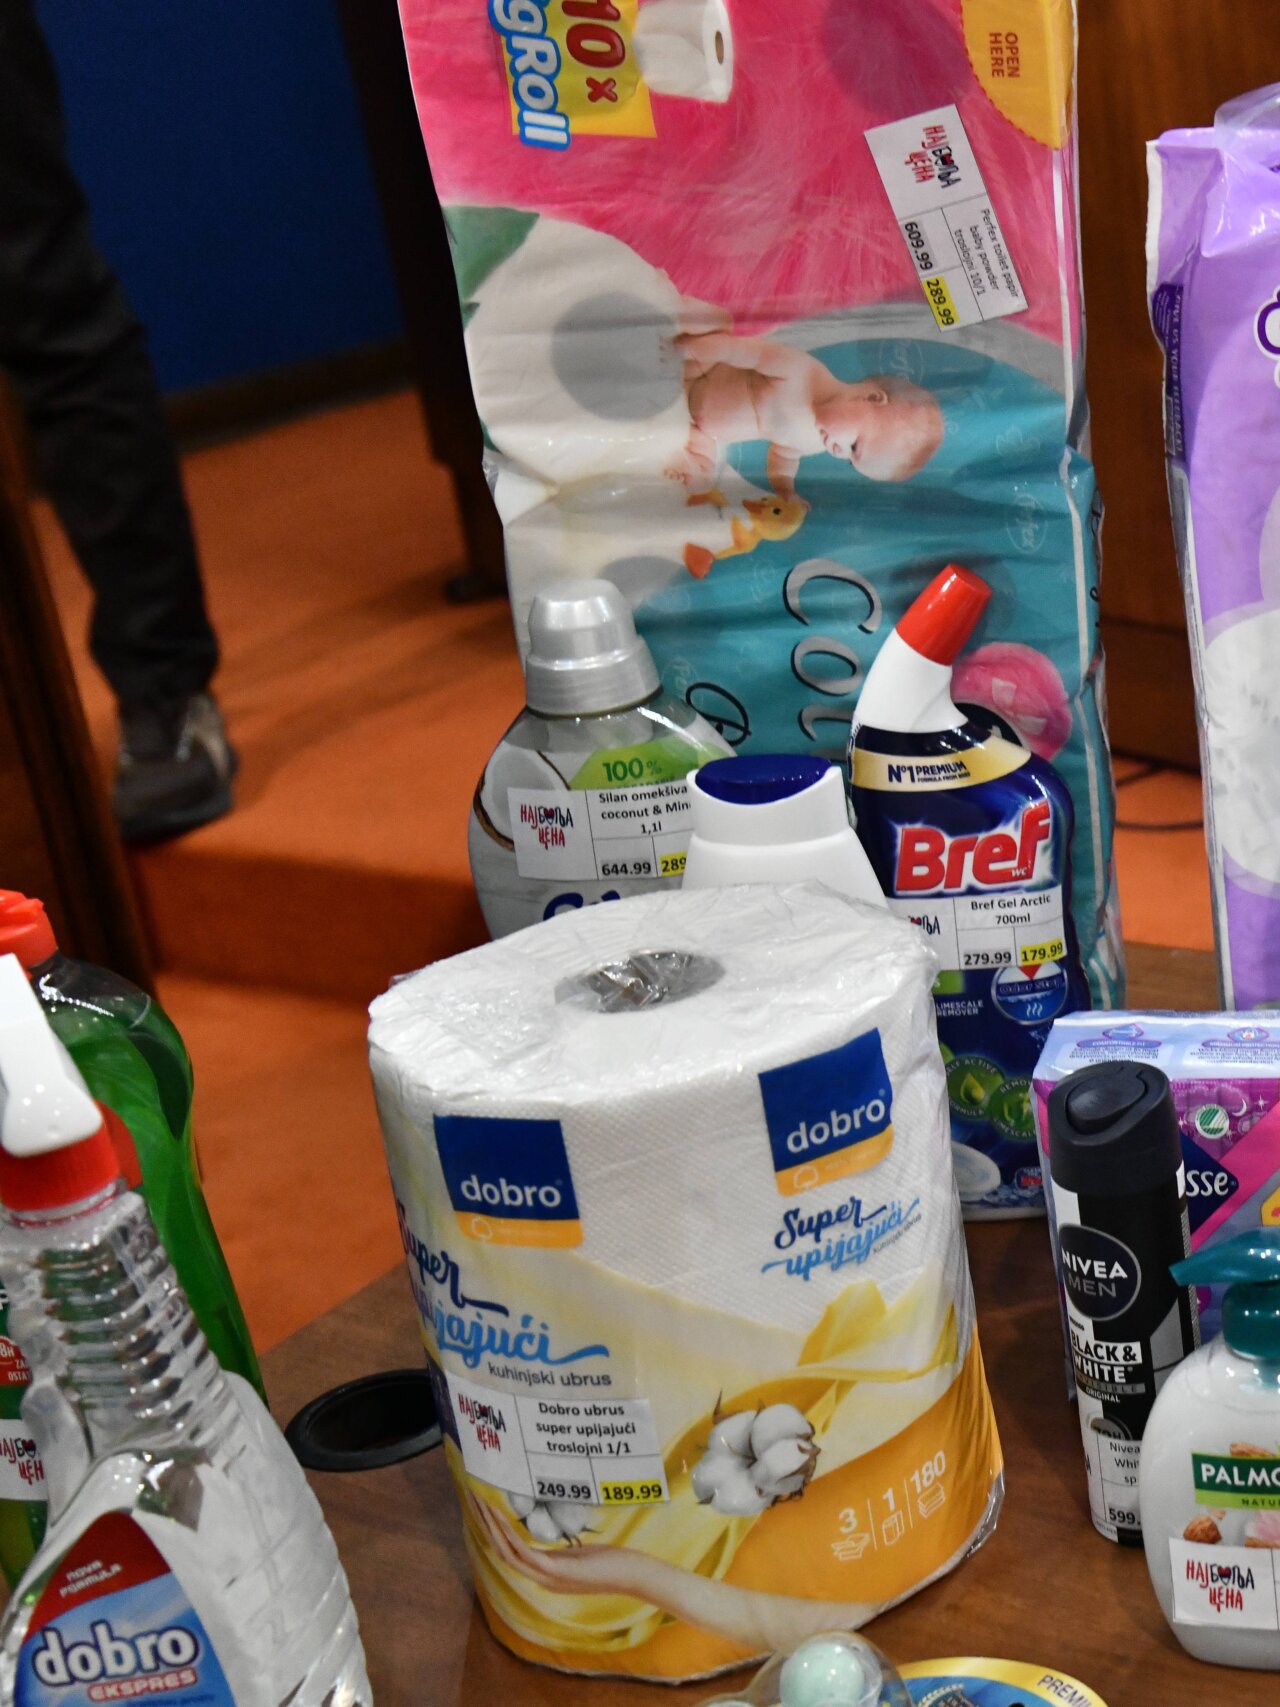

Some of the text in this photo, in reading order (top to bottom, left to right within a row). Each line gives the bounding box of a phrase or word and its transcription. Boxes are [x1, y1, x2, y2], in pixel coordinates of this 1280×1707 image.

[989, 32, 1004, 78] HERE
[1005, 32, 1020, 78] OPEN
[954, 229, 986, 295] troslojni 10/1
[969, 225, 999, 291] baby powder
[981, 208, 1018, 298] Perfex papir
[904, 221, 955, 327] 609.99 289.99
[916, 761, 967, 775] PREMIUM
[599, 792, 628, 803] Silan
[601, 804, 662, 820] coconut &
[641, 821, 662, 835] 1,1l
[896, 802, 1051, 891] Bref
[602, 862, 651, 876] 644.99
[971, 894, 1051, 911] Bref Gel Arctic
[996, 913, 1031, 925] 700ml
[964, 942, 1063, 966] 279.99 179.99
[936, 1000, 983, 1009] LIMESCALE
[937, 1008, 979, 1017] REMOVER
[787, 1099, 886, 1154] dobro
[461, 1174, 562, 1208] dobro
[775, 1196, 887, 1249] Super
[1061, 1248, 1128, 1280] NIVEA
[1068, 1276, 1117, 1298] MEN
[488, 1362, 612, 1387] kuhinjski ubrus
[1074, 1354, 1127, 1383] WHITE
[1086, 1386, 1120, 1404] ORIGINAL
[538, 1402, 624, 1416] Dobro ubrus
[536, 1421, 636, 1437] super upijajući
[547, 1441, 631, 1457] troslojni 1/1
[1110, 1442, 1140, 1453] Nivea
[537, 1481, 662, 1501] 249.99 189.99
[839, 1450, 946, 1533] 3 1 180
[1209, 1587, 1243, 1613] ЦЕНА
[33, 1619, 198, 1686] dobro
